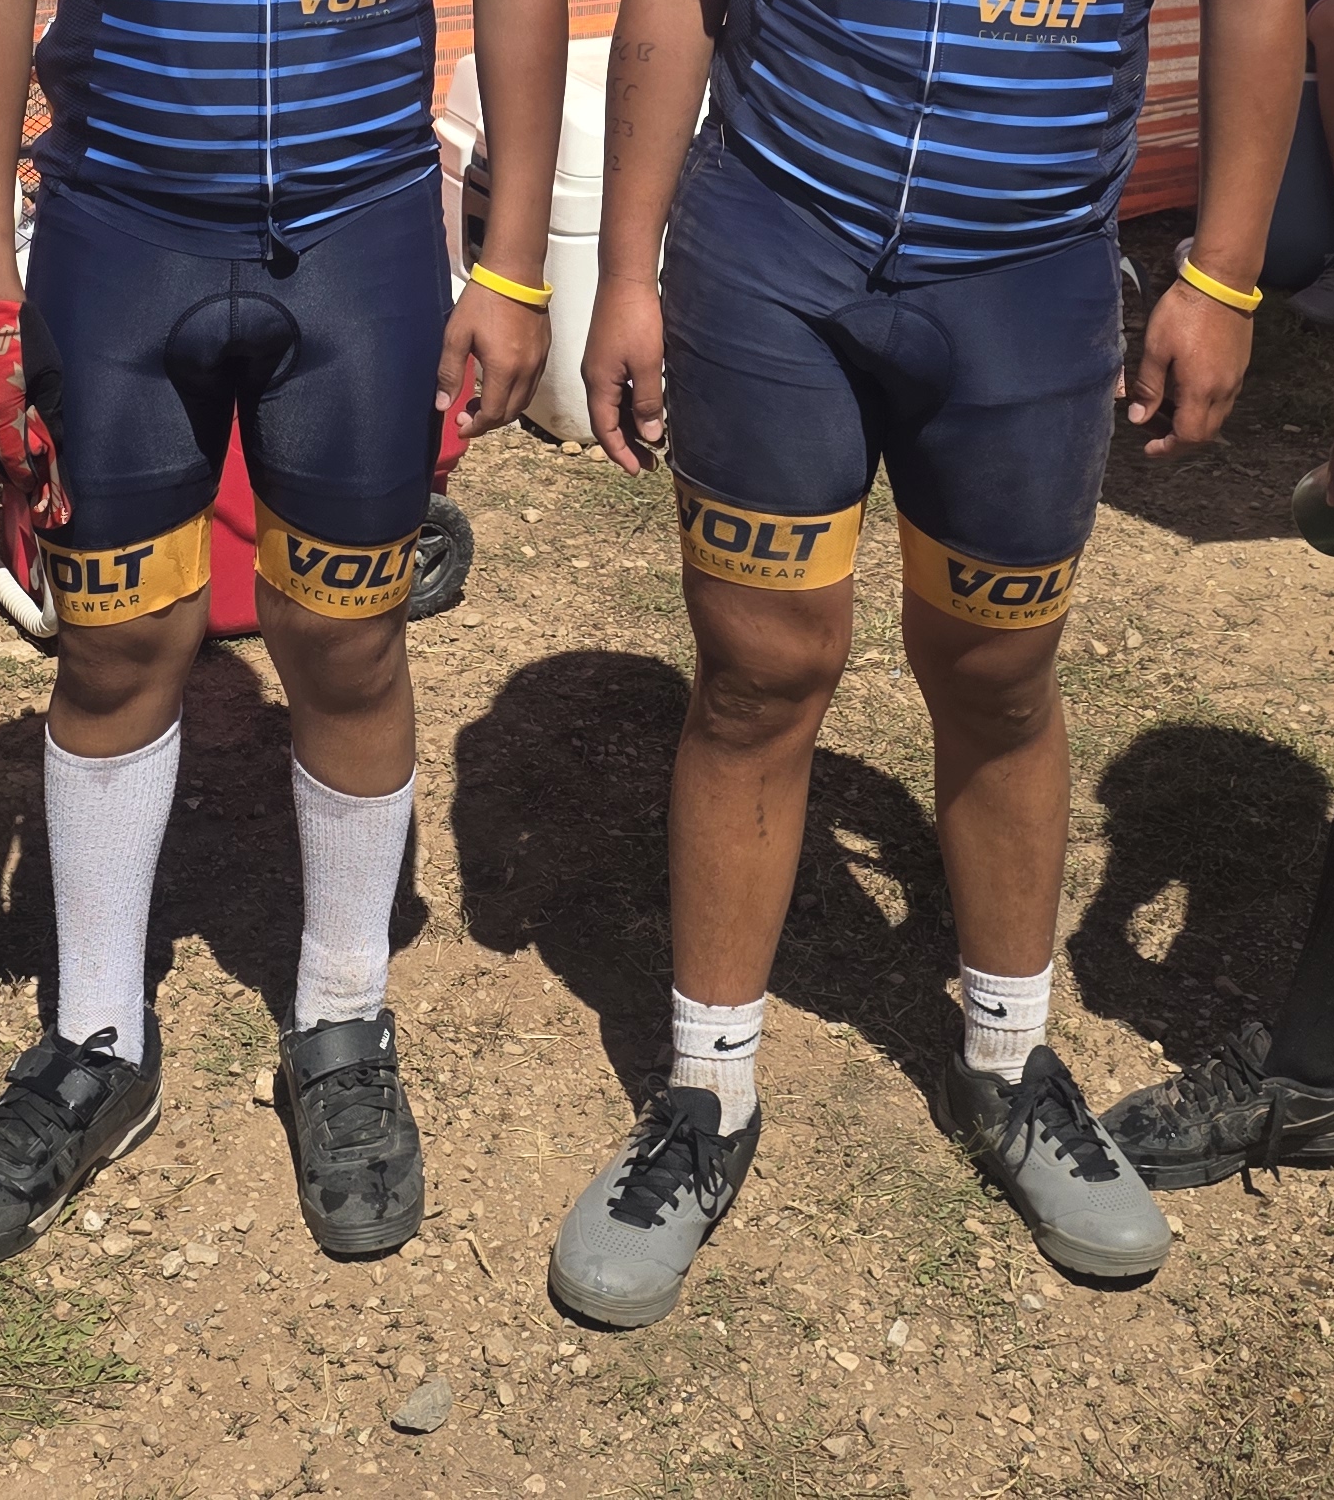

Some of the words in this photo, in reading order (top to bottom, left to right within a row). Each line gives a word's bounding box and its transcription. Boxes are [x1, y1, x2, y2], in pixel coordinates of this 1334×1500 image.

[978, 30, 1079, 45] CYCLEWEAR
[678, 488, 832, 562] VOLT
[41, 544, 154, 595] OLT
[286, 533, 417, 590] VOLT
[290, 577, 400, 606] CYCLEWEAR
